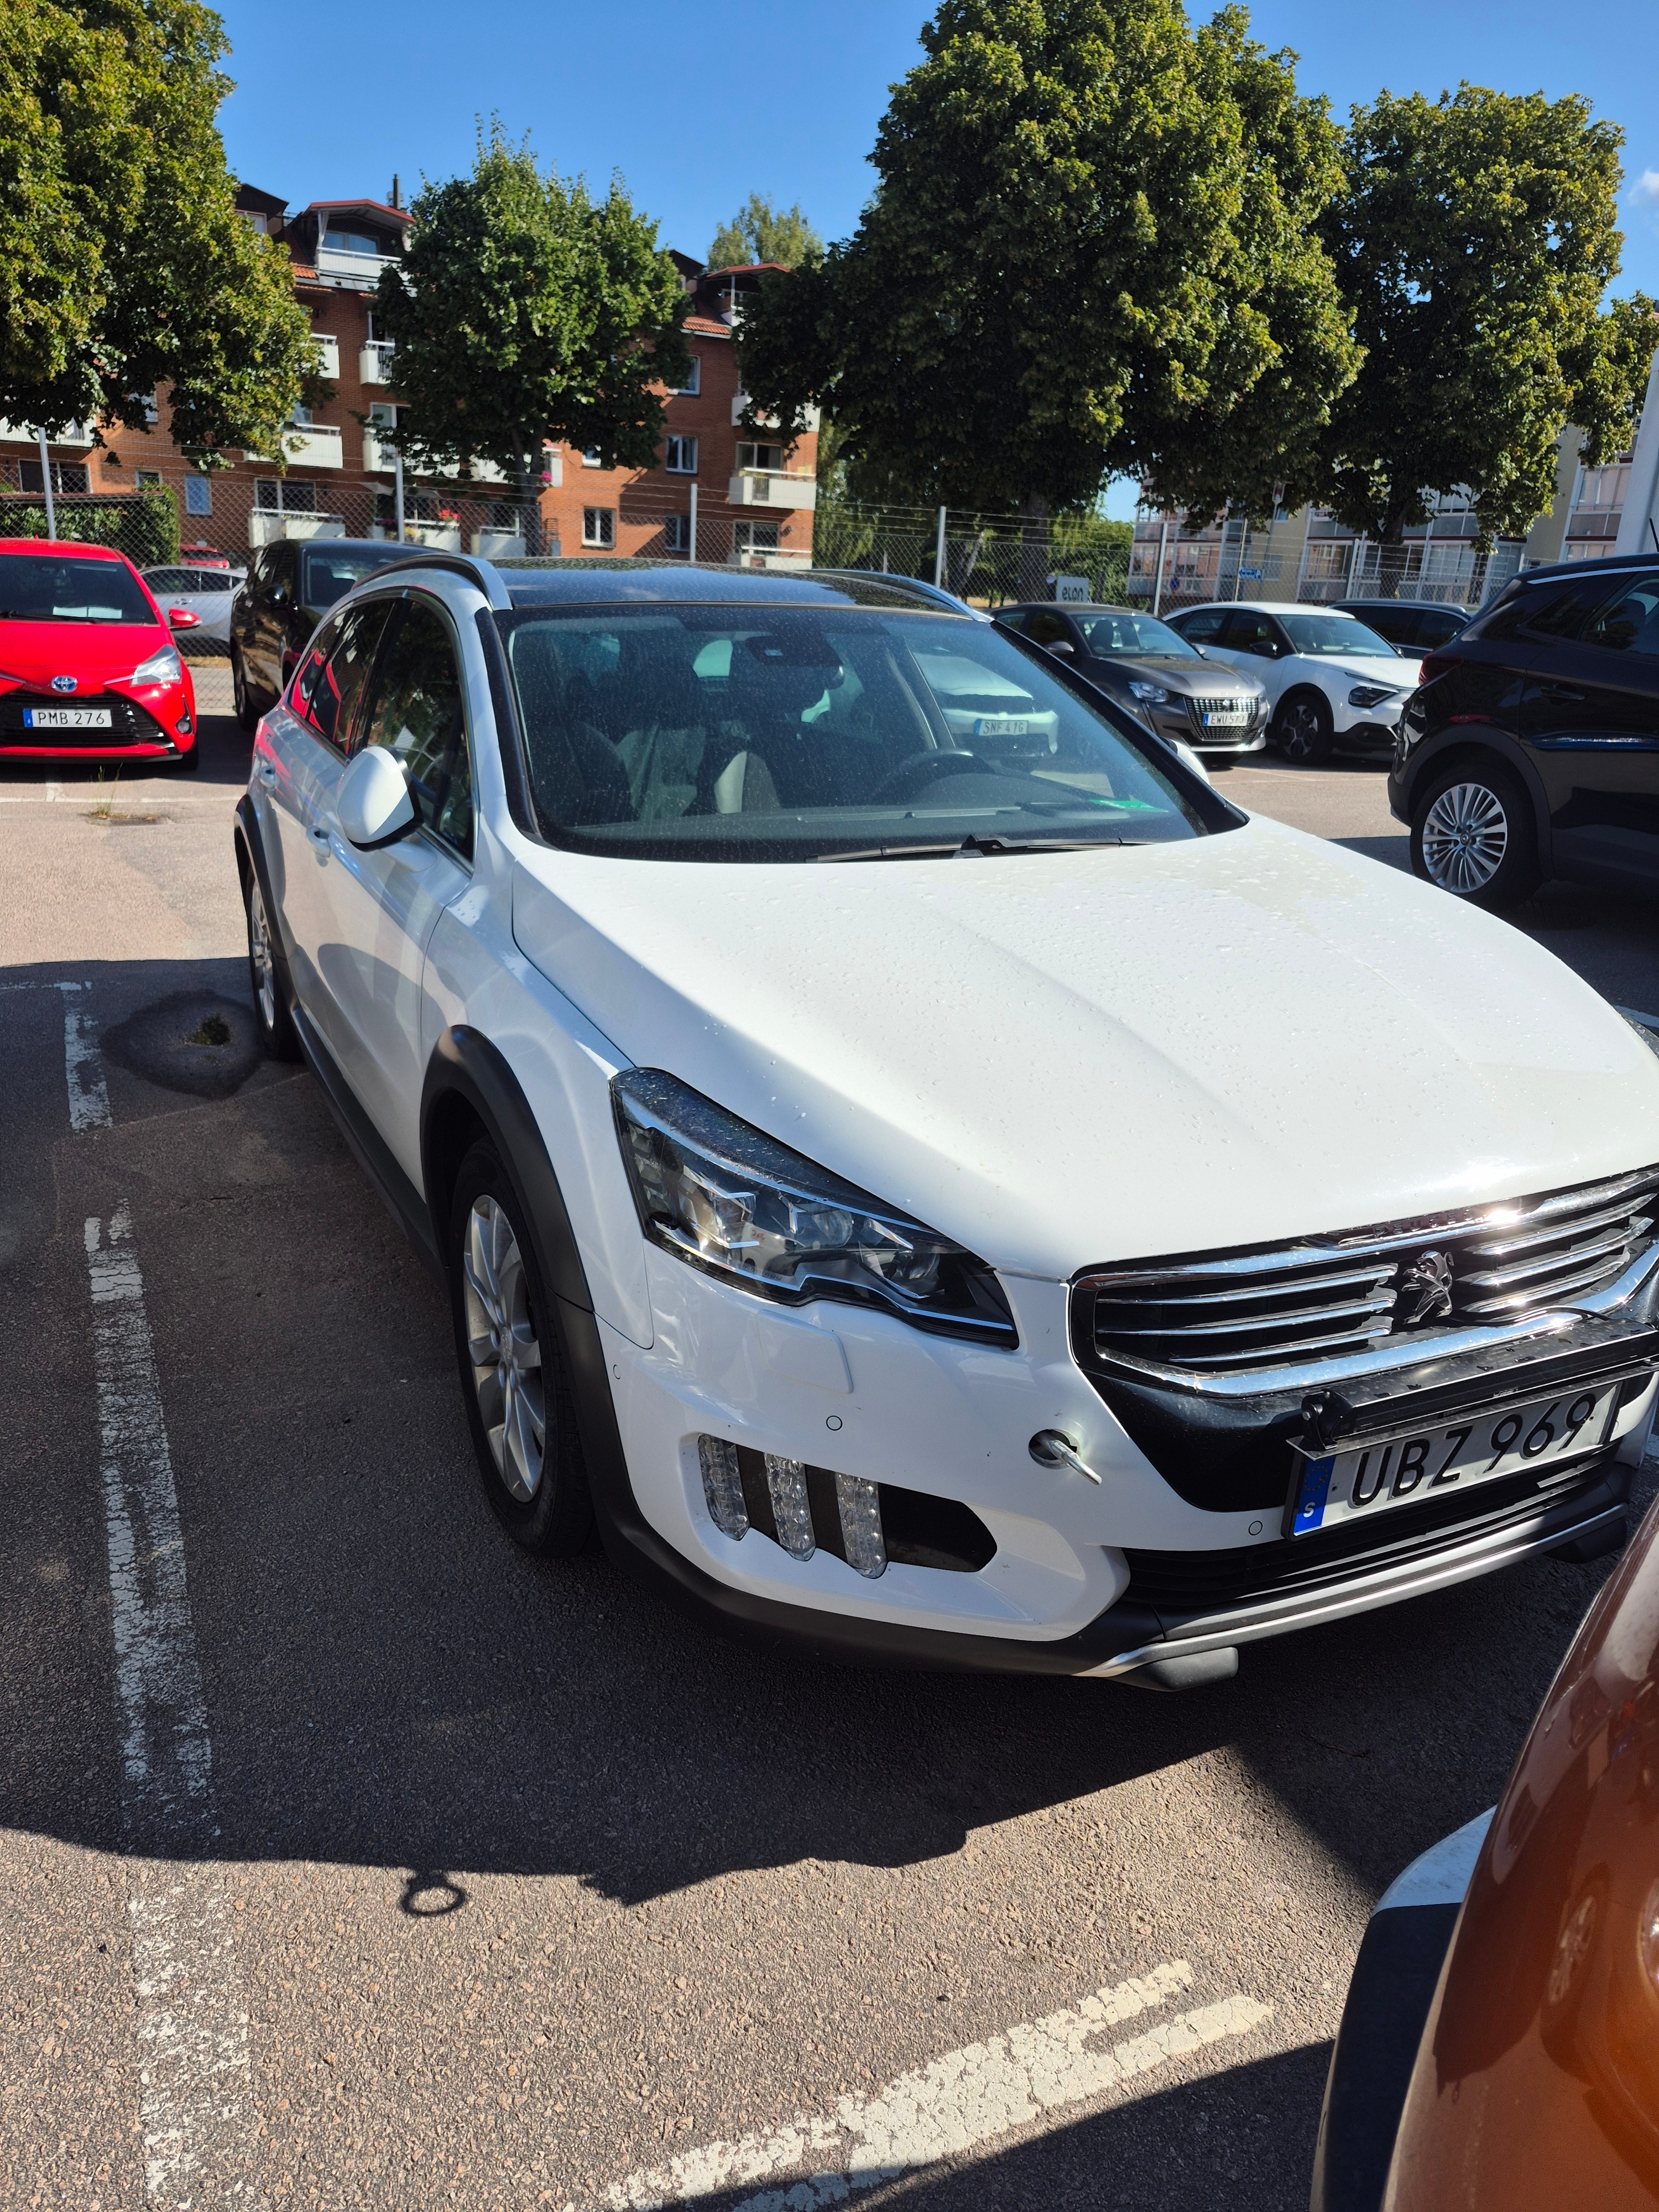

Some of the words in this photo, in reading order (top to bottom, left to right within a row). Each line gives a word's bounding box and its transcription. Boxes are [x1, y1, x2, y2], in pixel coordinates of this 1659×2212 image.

[38, 712, 68, 724] PMB
[75, 712, 105, 724] 276
[1211, 715, 1227, 724] EWU
[1229, 715, 1244, 724] 57J
[983, 722, 1003, 734] SNF
[1373, 1209, 1485, 1238] PEUGEO
[1350, 1426, 1473, 1506] UBZ
[1483, 1393, 1597, 1473] 969
[1303, 1502, 1316, 1517] S
